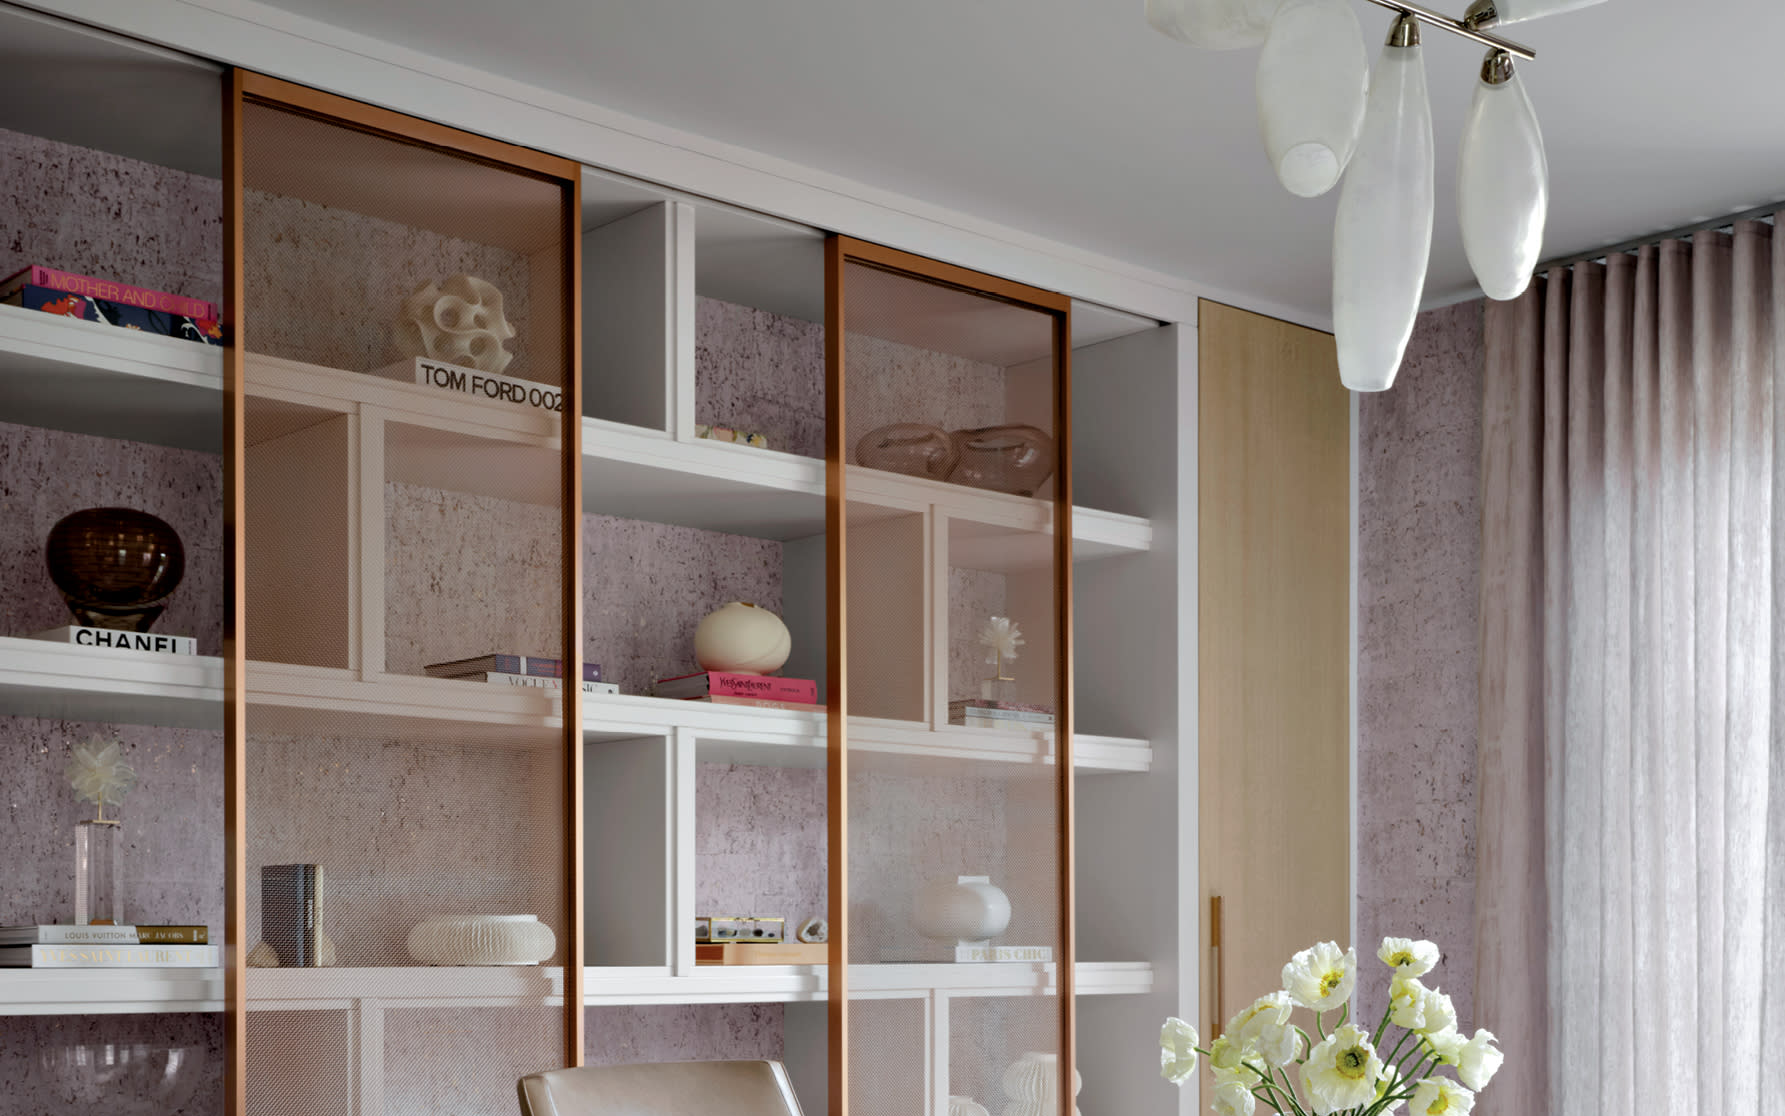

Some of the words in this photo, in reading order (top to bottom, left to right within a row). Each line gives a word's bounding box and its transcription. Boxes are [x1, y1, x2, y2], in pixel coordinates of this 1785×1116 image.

[50, 273, 119, 302] MOTHER
[122, 288, 156, 309] AND
[421, 364, 466, 393] TOM
[471, 375, 526, 404] FORD
[529, 388, 563, 412] 002
[64, 931, 89, 940] LOUIS
[92, 931, 126, 940] VUITTON
[129, 931, 151, 940] MARC
[155, 931, 184, 940] JACOBS
[40, 949, 78, 963] YVES
[77, 949, 122, 963] SAINT
[127, 949, 193, 963] LAURENT
[971, 948, 1012, 960] PARIS
[1014, 948, 1043, 960] CHIC
